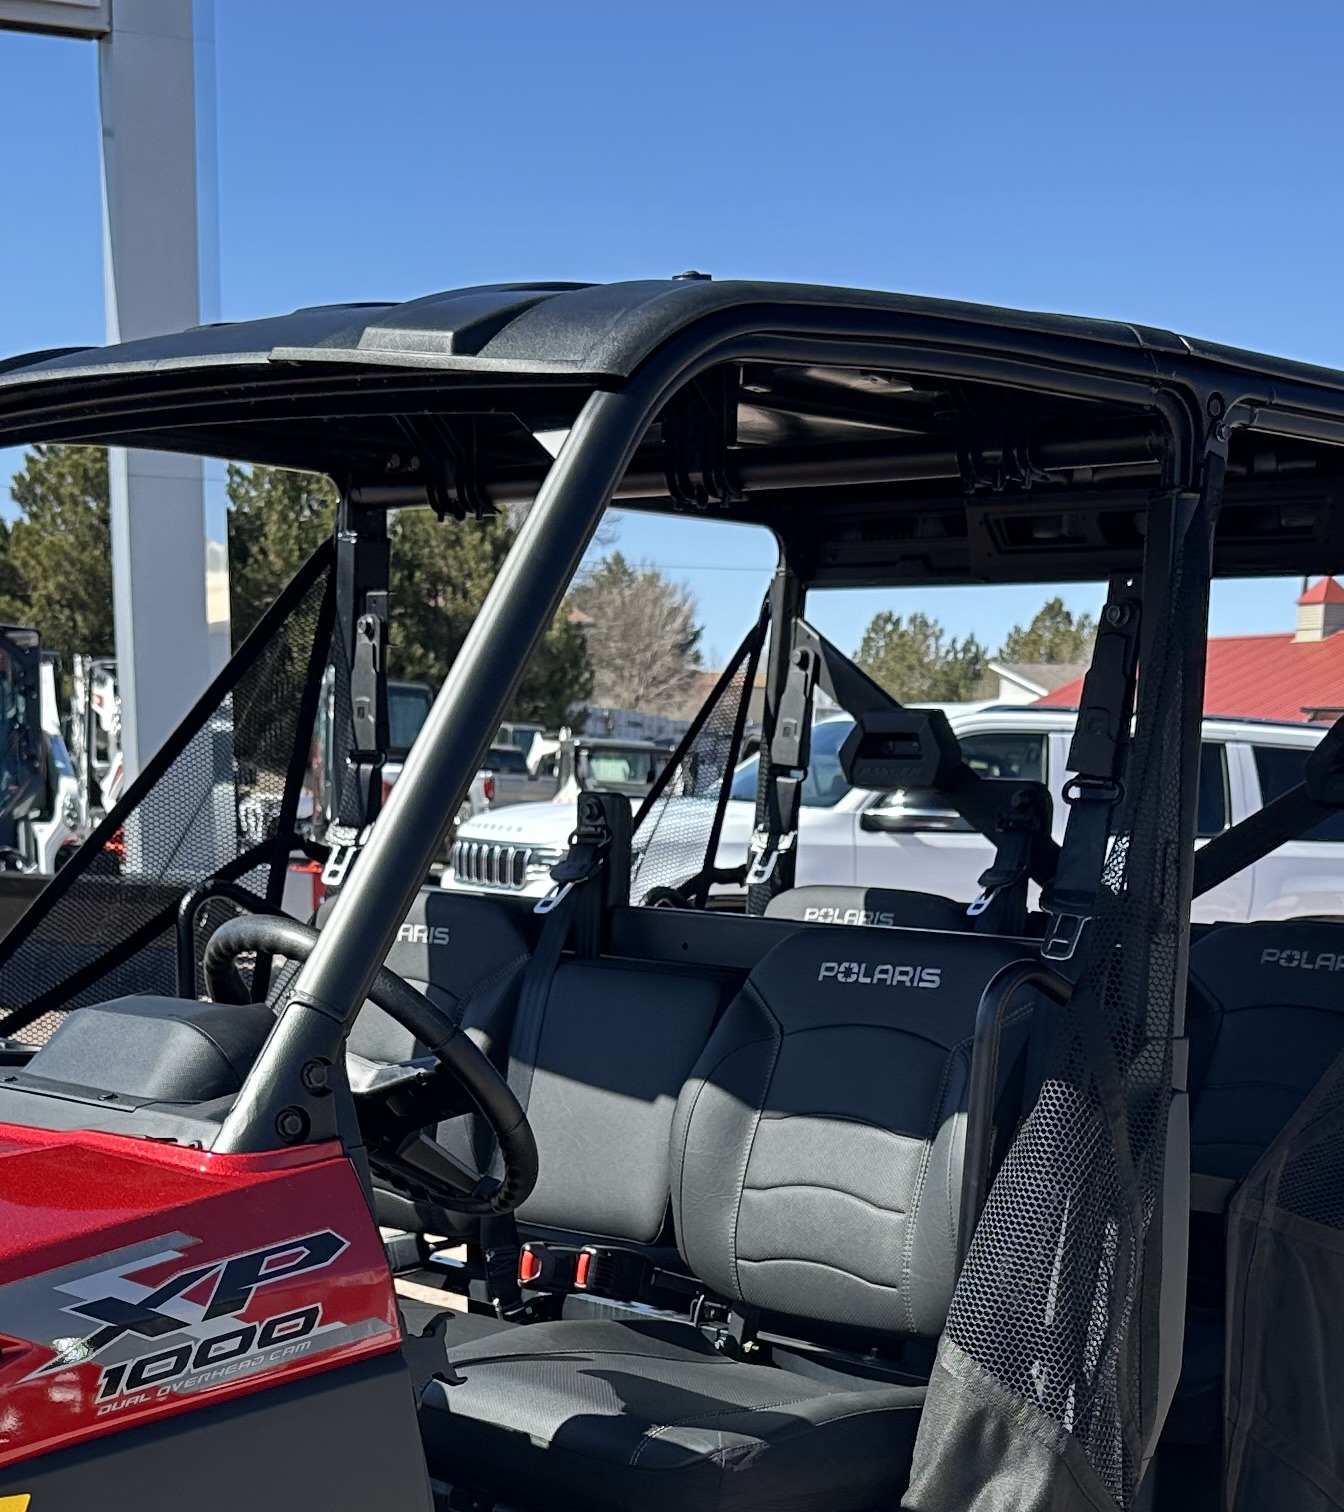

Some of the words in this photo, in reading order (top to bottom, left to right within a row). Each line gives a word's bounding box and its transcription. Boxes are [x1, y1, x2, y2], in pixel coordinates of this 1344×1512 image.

[398, 924, 450, 944] ARIS
[804, 908, 895, 926] POLARIS
[817, 961, 942, 989] POLARIS
[18, 1228, 352, 1384] XP
[94, 1303, 323, 1405] 1000
[96, 1391, 152, 1417] DUAL
[156, 1356, 265, 1398] OVERHEAD
[268, 1340, 312, 1361] CAM
